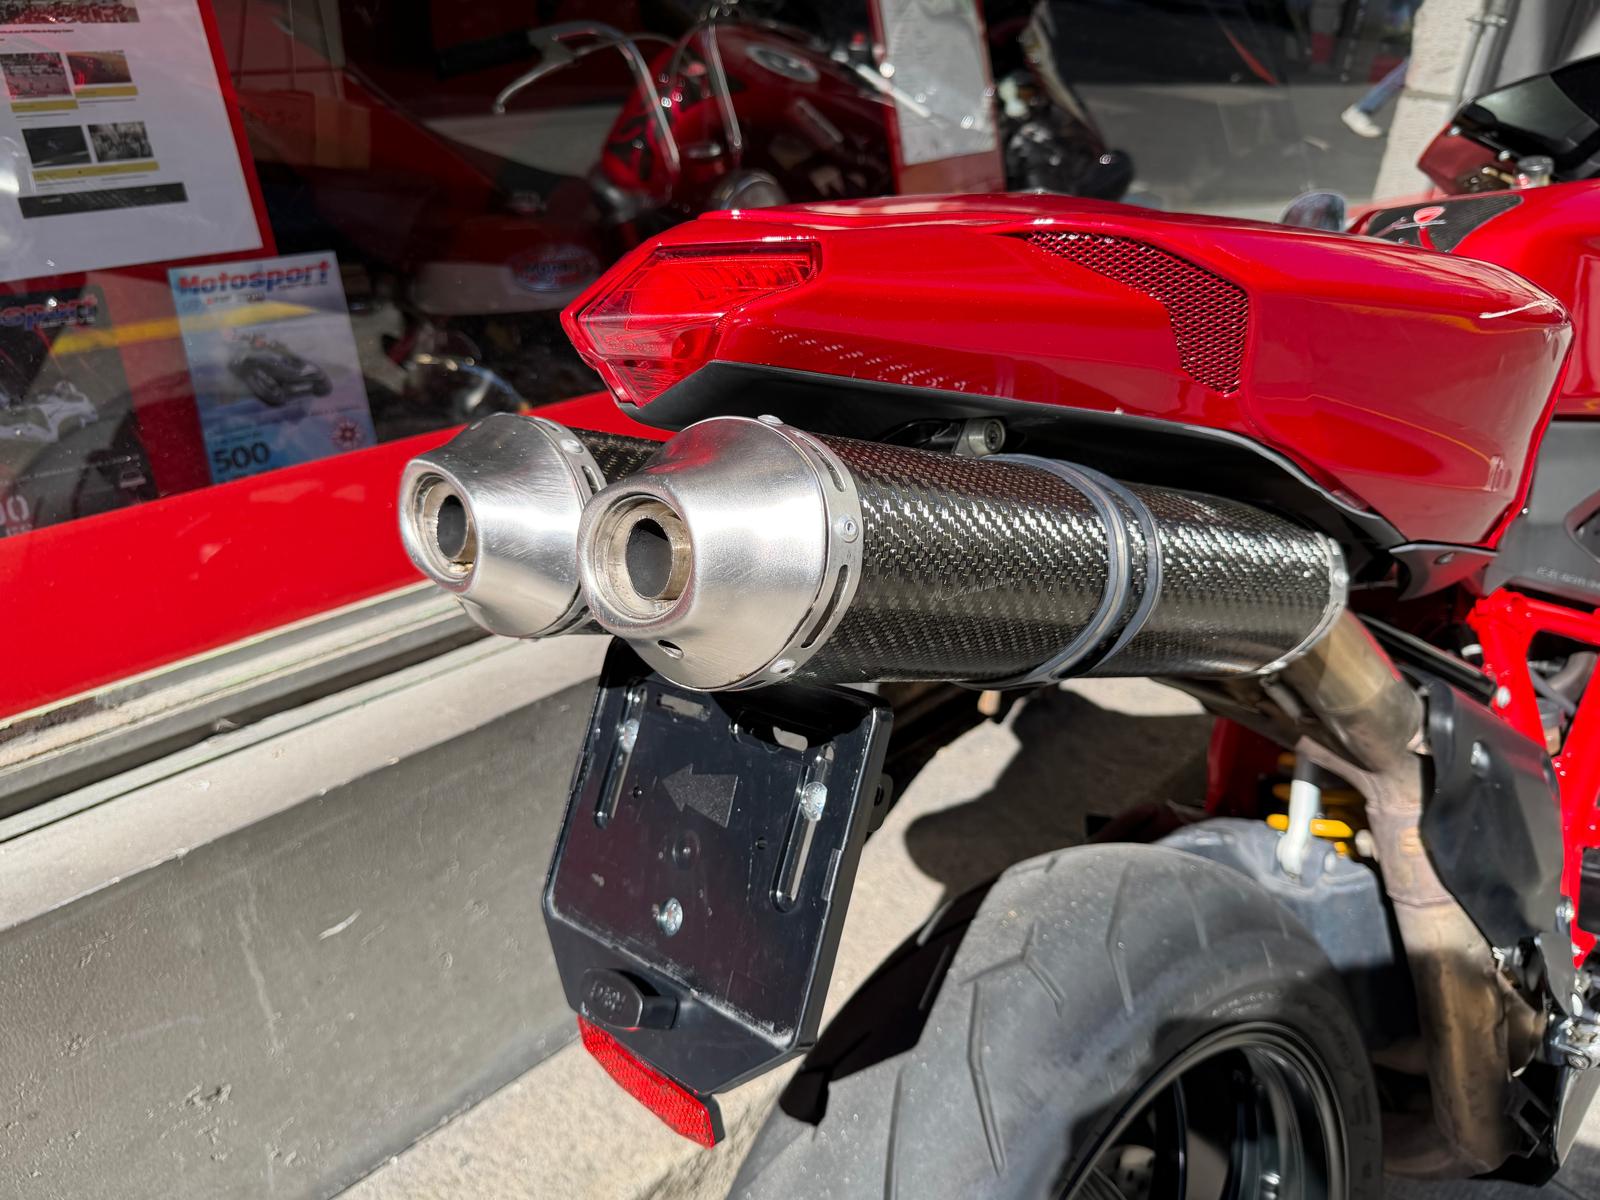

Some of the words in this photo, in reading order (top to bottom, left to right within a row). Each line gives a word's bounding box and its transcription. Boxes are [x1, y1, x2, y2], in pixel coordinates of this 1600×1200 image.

[179, 260, 330, 295] Motosport
[0, 293, 97, 331] sport
[214, 441, 271, 473] 500
[0, 494, 29, 525] 0
